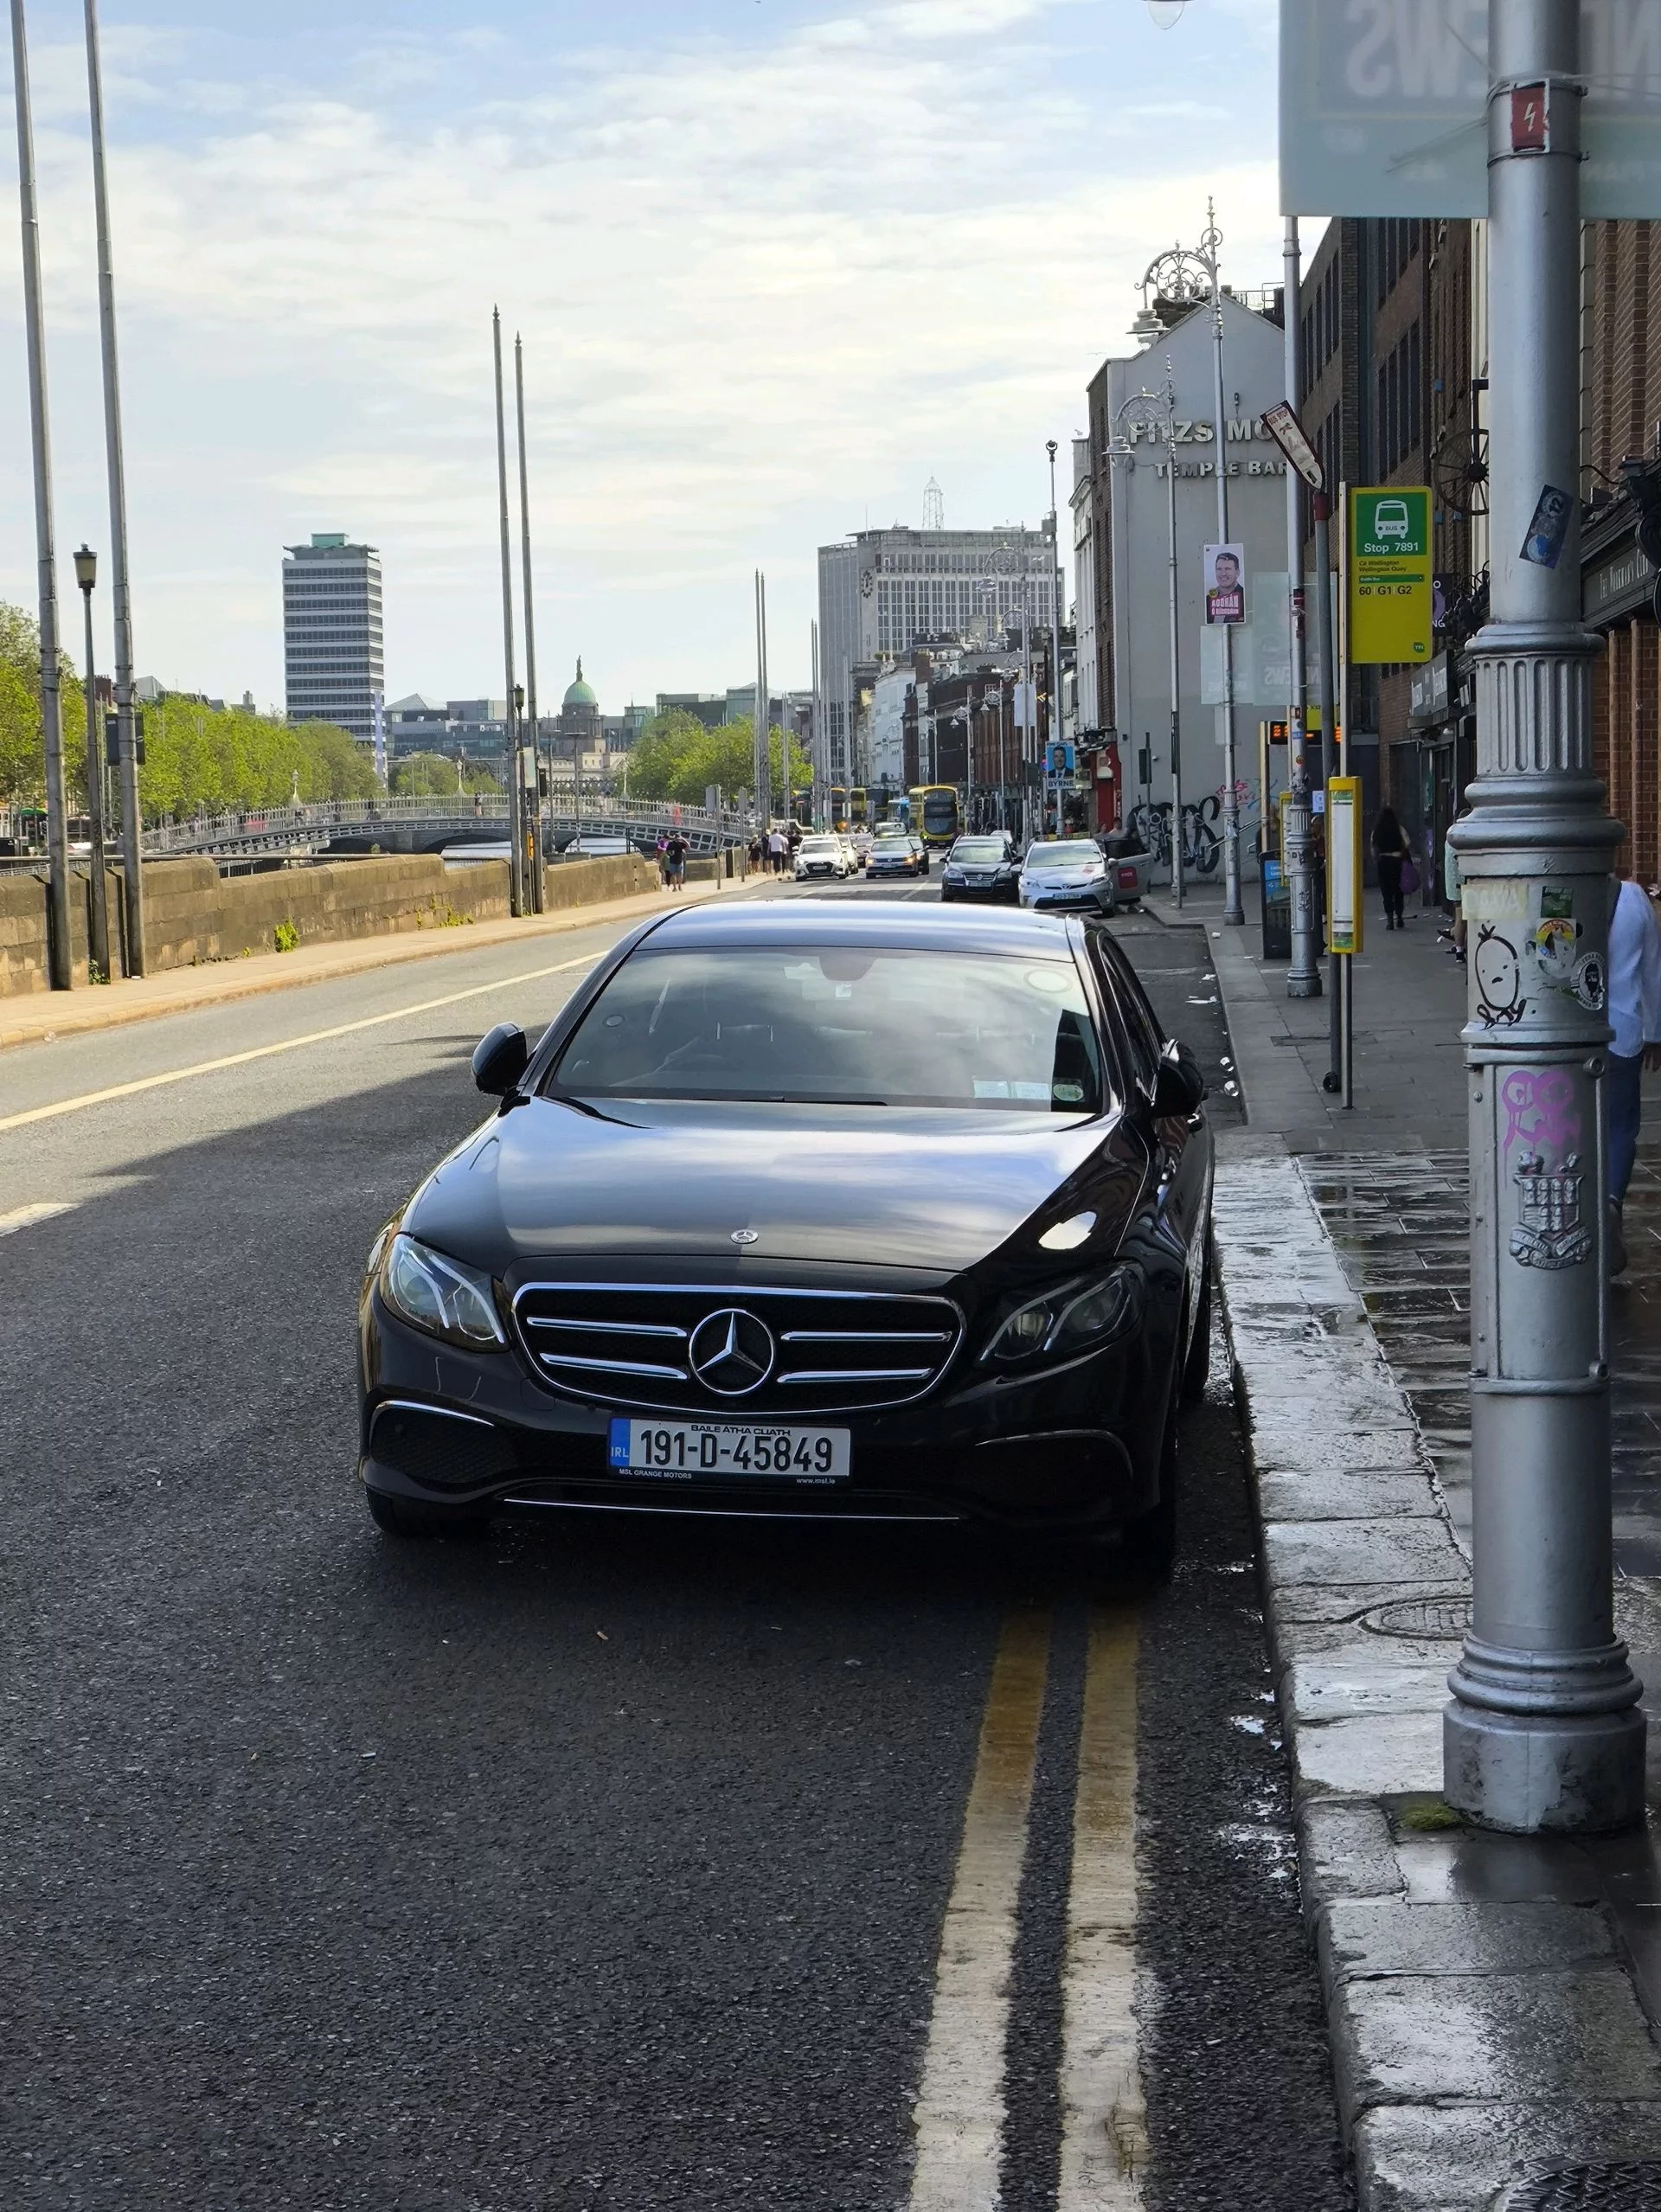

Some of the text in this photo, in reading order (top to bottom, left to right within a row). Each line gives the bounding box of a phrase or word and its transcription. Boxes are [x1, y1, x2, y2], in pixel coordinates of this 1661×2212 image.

[1364, 542, 1419, 555] Stop 7891
[1359, 585, 1413, 596] 60 G1 G2
[690, 1424, 791, 1436] BAILE ÁTHA CLIATH
[610, 1447, 630, 1459] IRL
[640, 1429, 833, 1473] 191-D-45849
[634, 1469, 663, 1478] GRANGE
[664, 1471, 692, 1480] MOTORS
